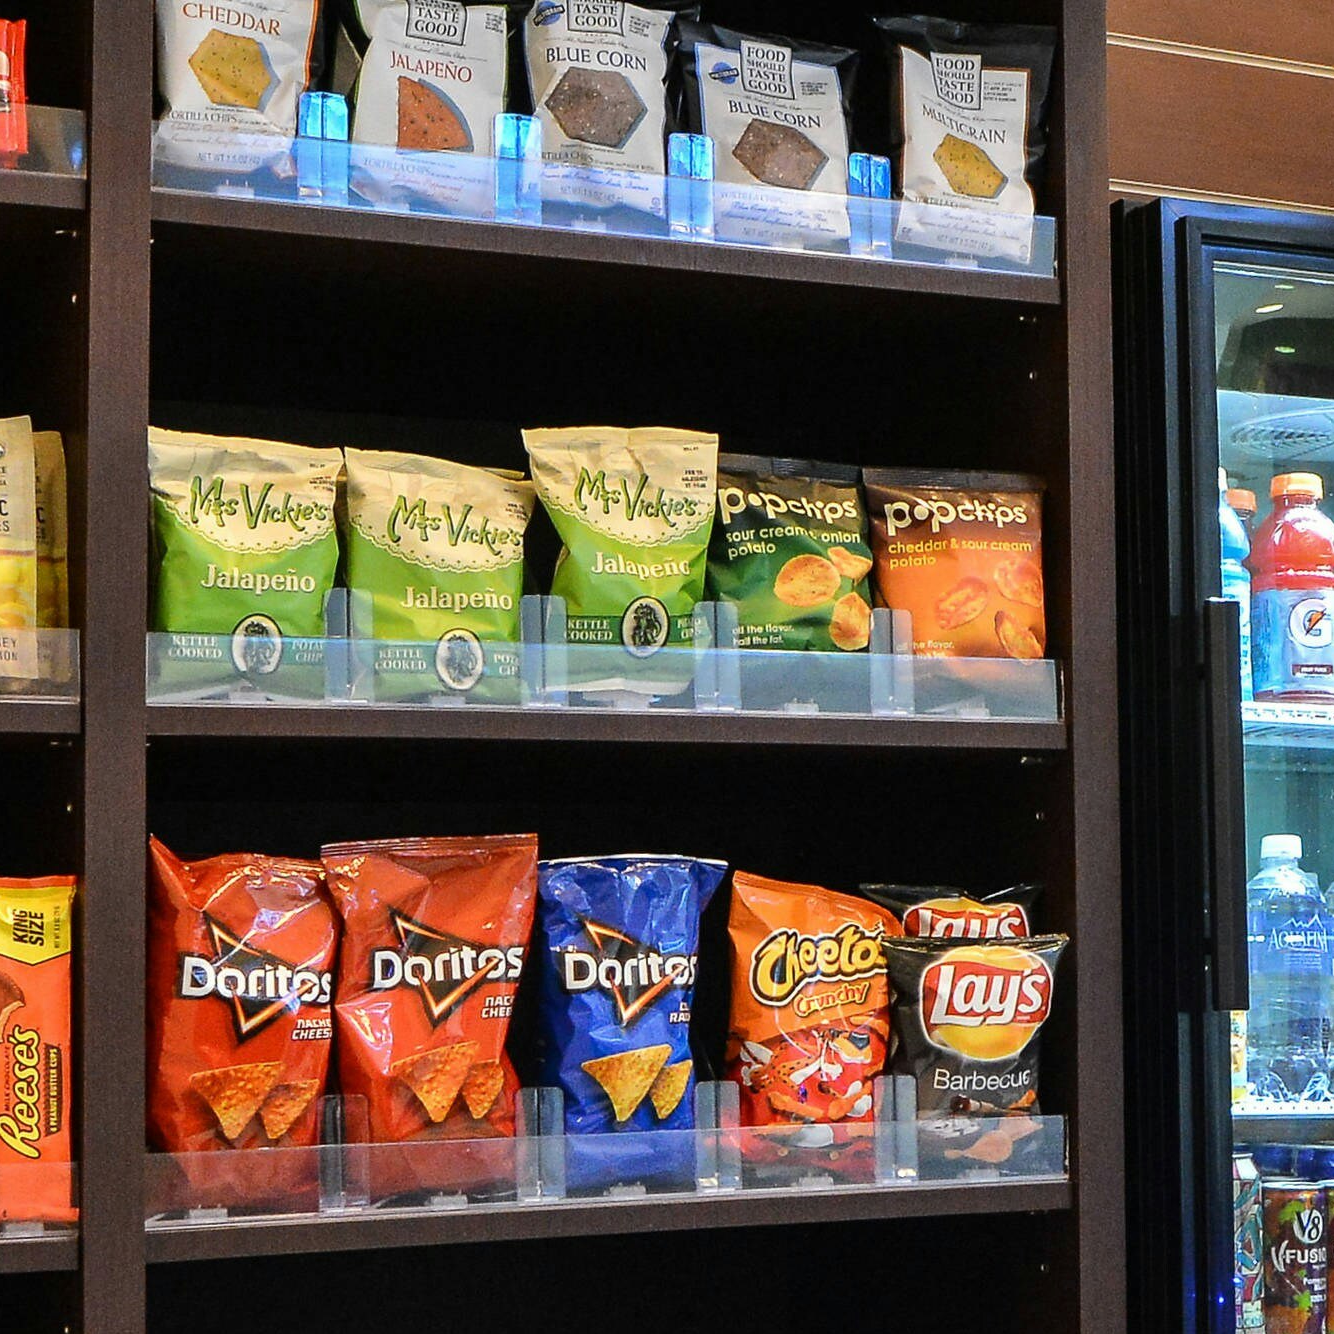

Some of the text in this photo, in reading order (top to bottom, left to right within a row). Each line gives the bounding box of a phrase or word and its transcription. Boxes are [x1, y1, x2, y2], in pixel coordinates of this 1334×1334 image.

[575, 4, 617, 17] TASTE
[182, 3, 281, 36] CHEDDAR
[574, 14, 618, 28] GOOD
[414, 20, 458, 37] GOOD
[545, 46, 647, 71] BLUE CORN
[746, 46, 787, 62] FOOD
[390, 50, 473, 83] JALAPEÑO
[936, 58, 975, 71] FOOD
[746, 69, 787, 82] TASTE
[936, 69, 975, 80] SHOULD
[747, 79, 787, 94] GOOD
[937, 77, 975, 92] TASTE
[940, 87, 974, 104] GOOD
[728, 99, 822, 129] BLUE CORN
[922, 103, 1006, 144] MULTIGRAIN
[718, 487, 858, 525] popchips
[884, 498, 1028, 537] popchips
[726, 528, 755, 543] sour
[821, 530, 861, 543] onion
[728, 543, 777, 560] potato
[888, 538, 1033, 554] cheddar & sour cream
[889, 554, 937, 570] potato
[200, 563, 316, 595] Jalapeño
[400, 586, 513, 613] Jalapeño
[567, 618, 611, 630] KETTLE
[171, 634, 217, 647] KETTLE
[564, 629, 613, 641] COOKED
[374, 658, 427, 671] COOKED
[1268, 927, 1328, 952] AQUAFIN
[373, 945, 524, 989] Doritos
[564, 952, 698, 990] Doritos
[181, 955, 332, 1003] Doritos
[793, 981, 870, 1017] Crunchy
[931, 965, 1047, 1026] Lay's
[933, 1068, 1030, 1090] Barbecue
[1295, 1209, 1323, 1241] V8
